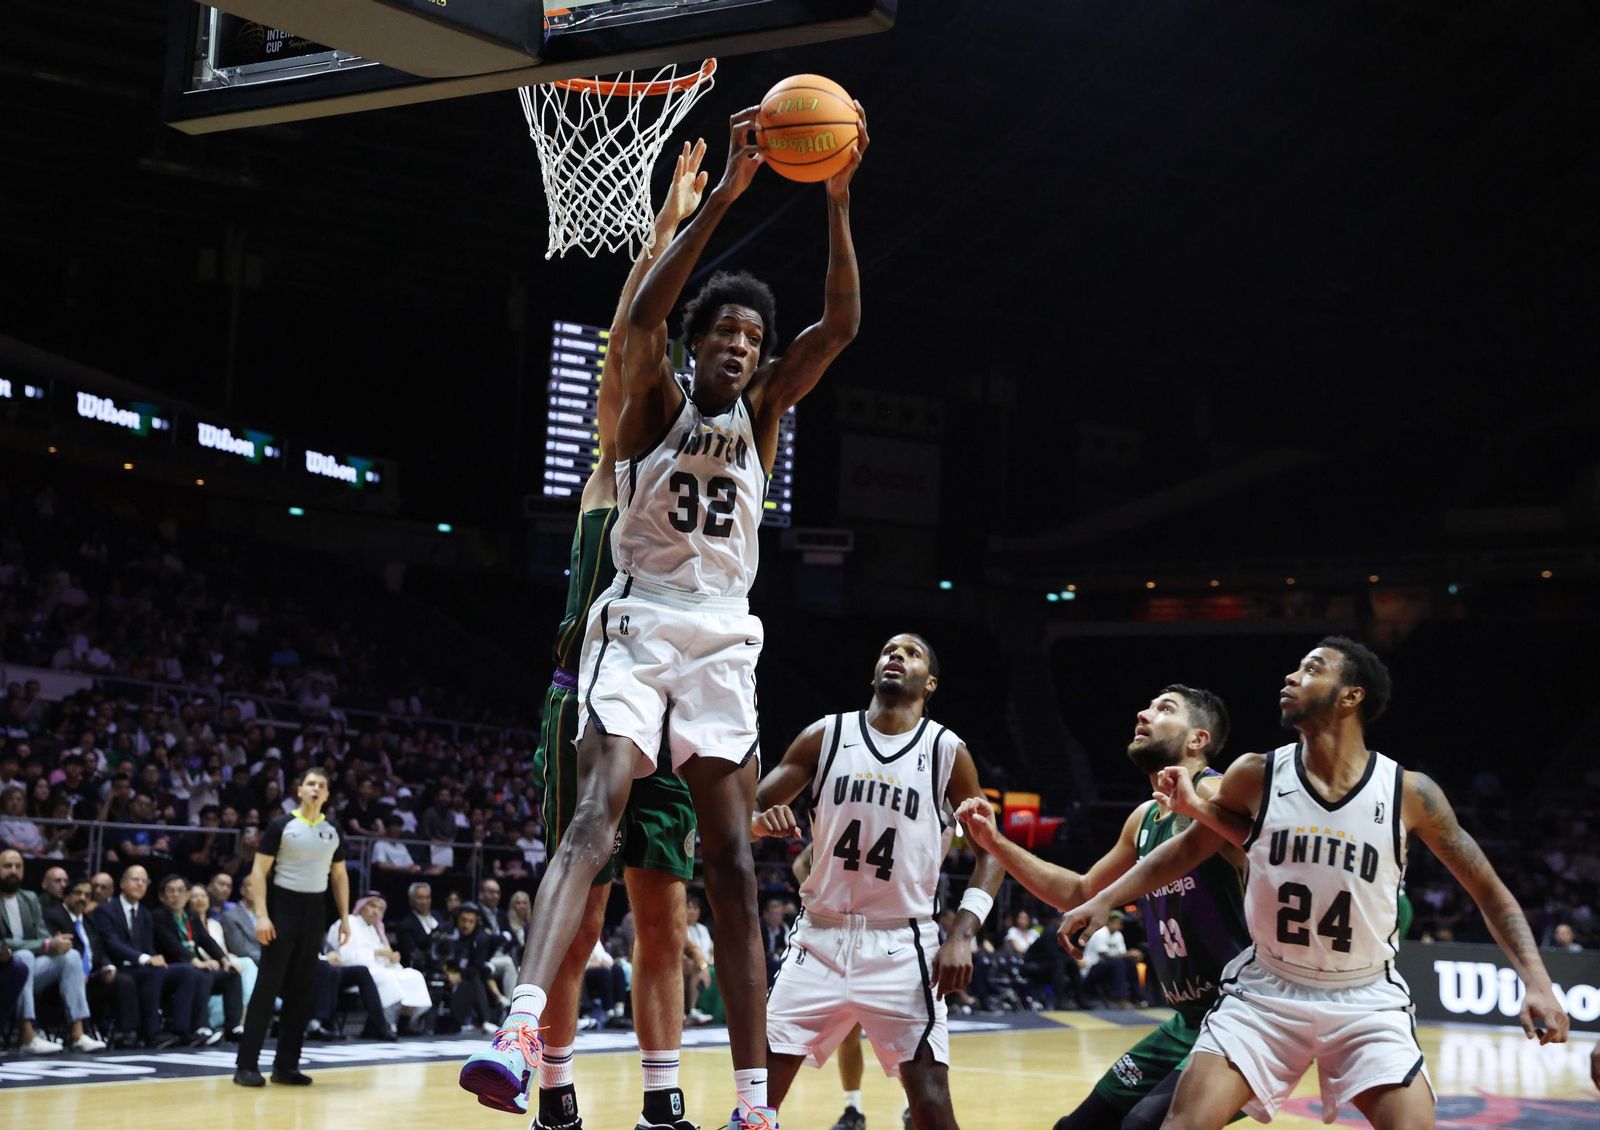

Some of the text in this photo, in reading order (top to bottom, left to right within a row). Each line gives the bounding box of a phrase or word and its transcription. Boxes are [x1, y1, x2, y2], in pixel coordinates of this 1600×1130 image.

[266, 41, 283, 54] CUP
[77, 391, 140, 430] Wilson
[197, 422, 255, 458] Wilson
[305, 449, 358, 484] Wilson
[667, 470, 738, 538] 32
[833, 774, 920, 821] UNITED
[832, 818, 897, 882] 44
[1268, 828, 1379, 884] UNITED
[1276, 881, 1354, 953] 24
[1433, 959, 1600, 1022] Wio
